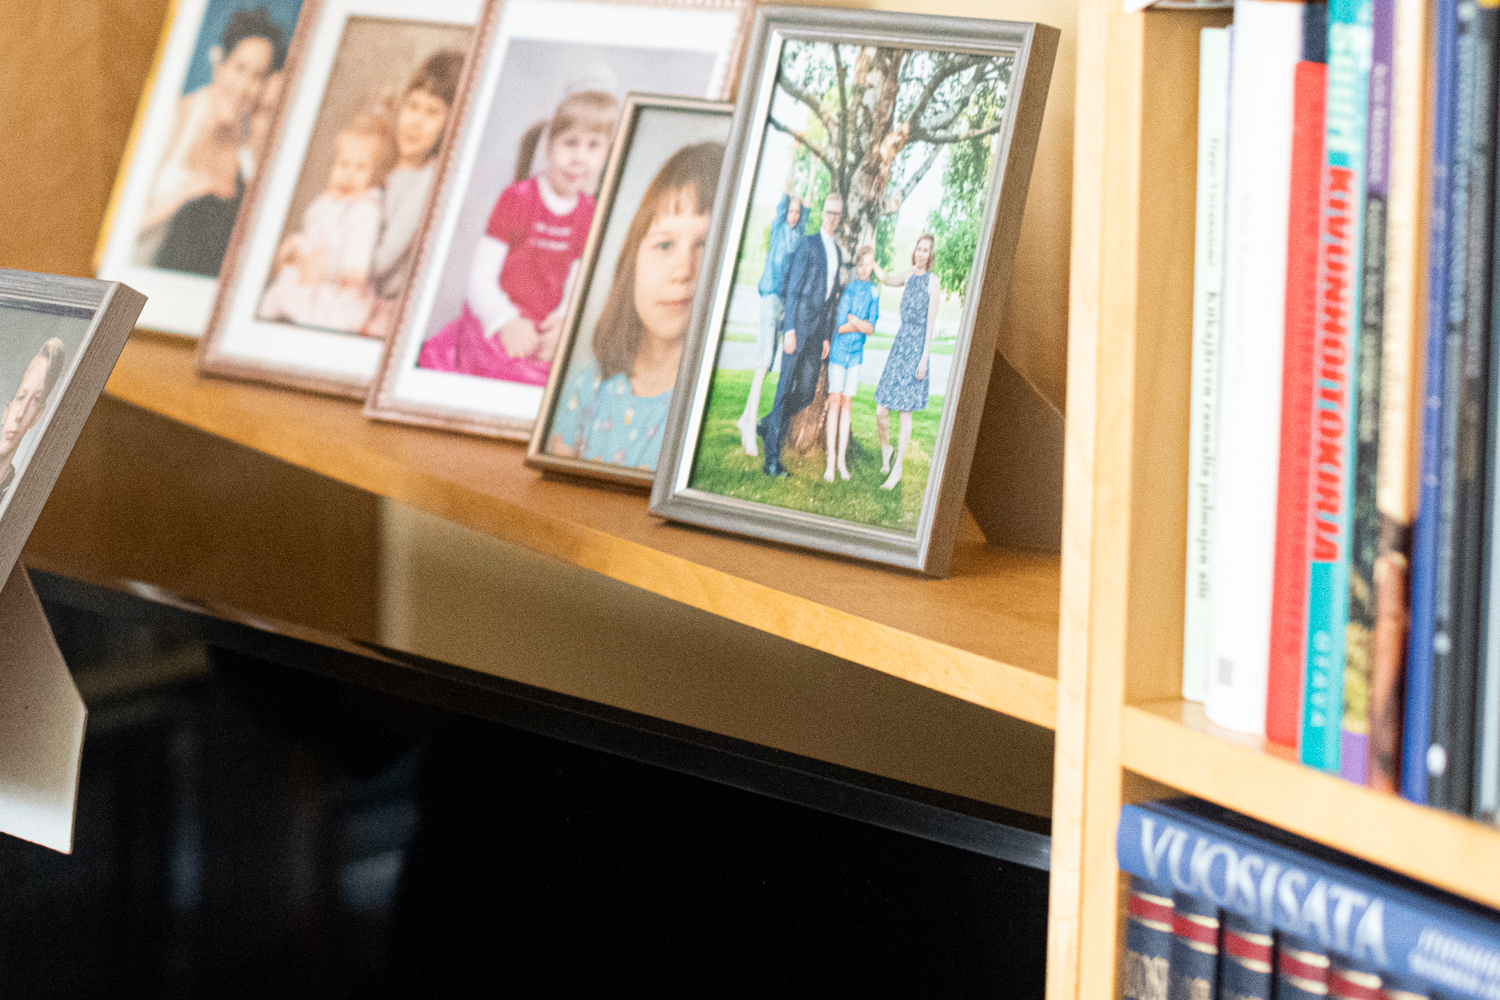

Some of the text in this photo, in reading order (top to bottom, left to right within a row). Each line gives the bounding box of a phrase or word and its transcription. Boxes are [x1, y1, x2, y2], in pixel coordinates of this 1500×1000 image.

[1197, 291, 1220, 600] Kitkajärven rannalta palmujen alle
[1312, 166, 1353, 562] KIVUNHOITOKIRJA
[1310, 629, 1332, 728] OTAVA
[1140, 815, 1389, 968] VUOSISATA
